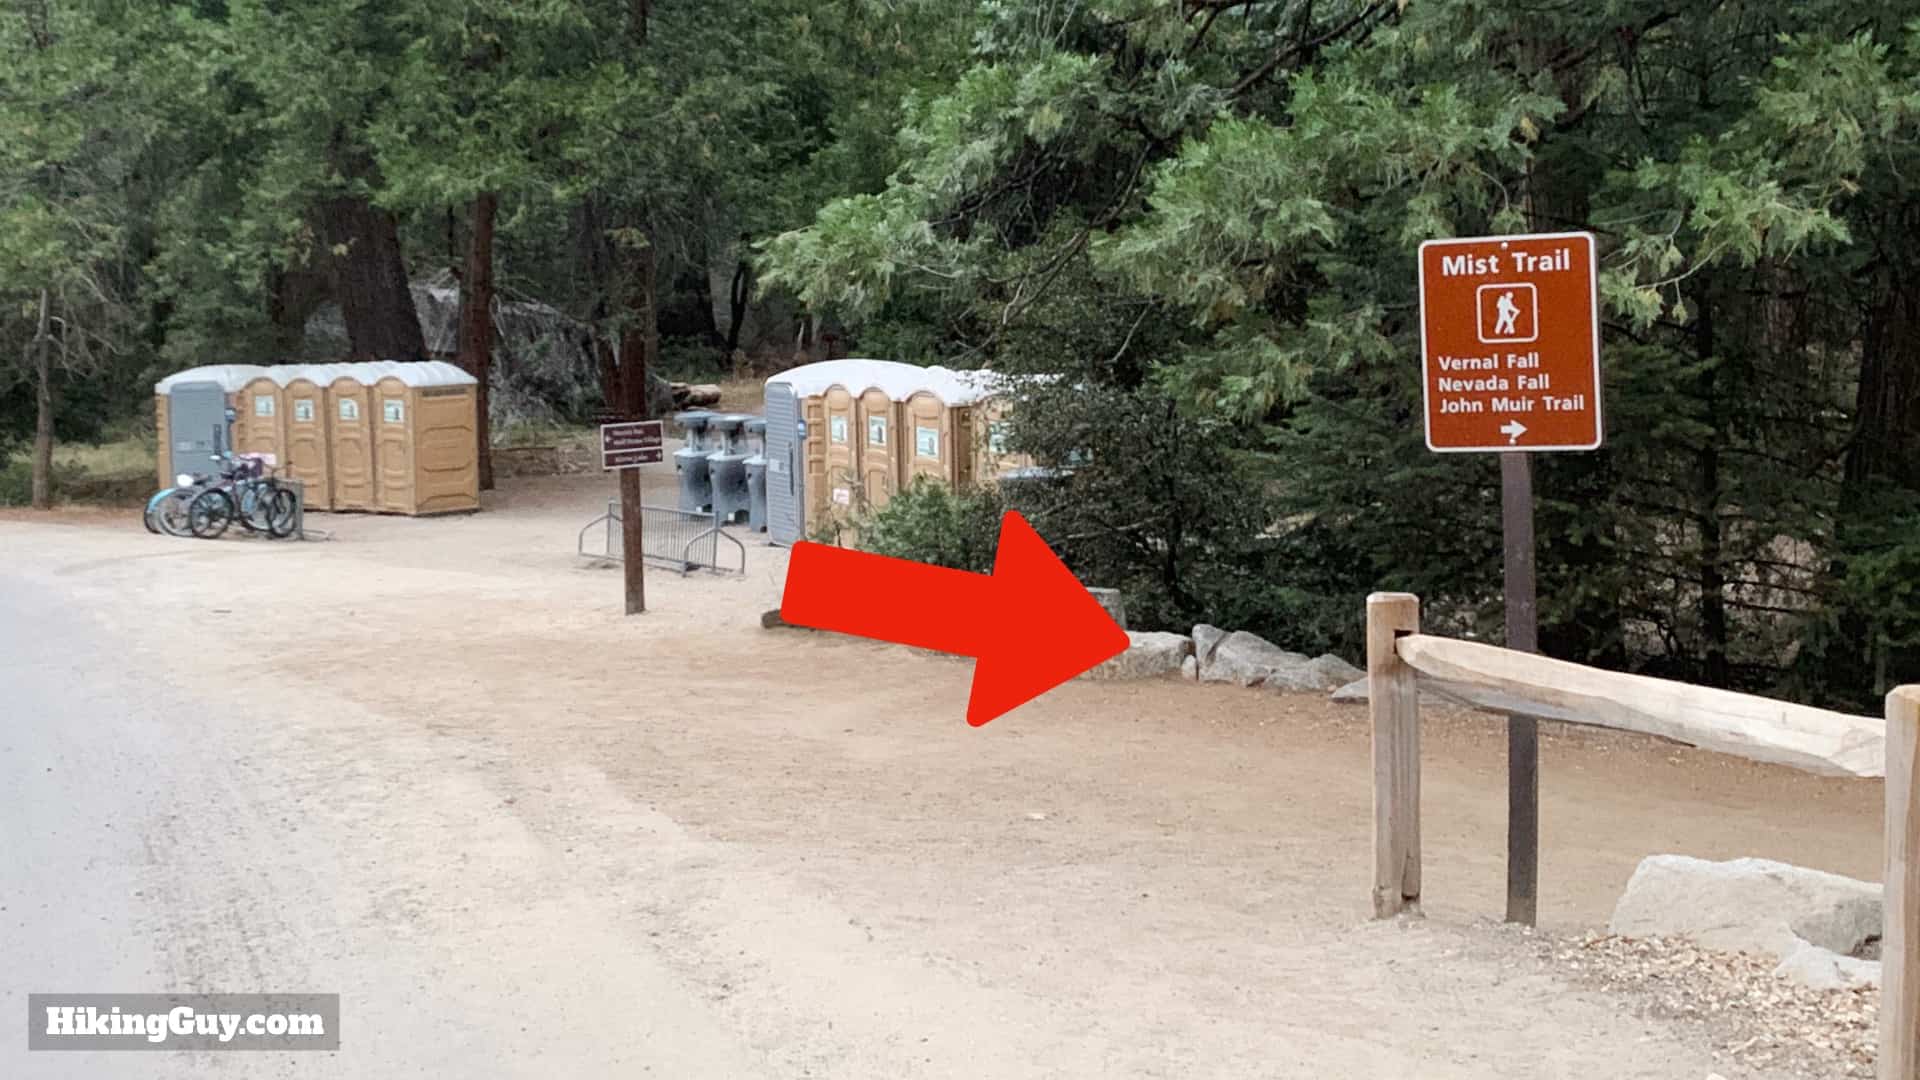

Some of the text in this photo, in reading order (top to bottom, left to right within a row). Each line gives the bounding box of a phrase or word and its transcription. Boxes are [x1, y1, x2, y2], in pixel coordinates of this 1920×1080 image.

[1442, 248, 1571, 277] Mist Trail
[1438, 351, 1540, 371] Vernal Fall
[1438, 373, 1550, 393] Nevada Fall
[1439, 394, 1585, 413] John Muir Trail
